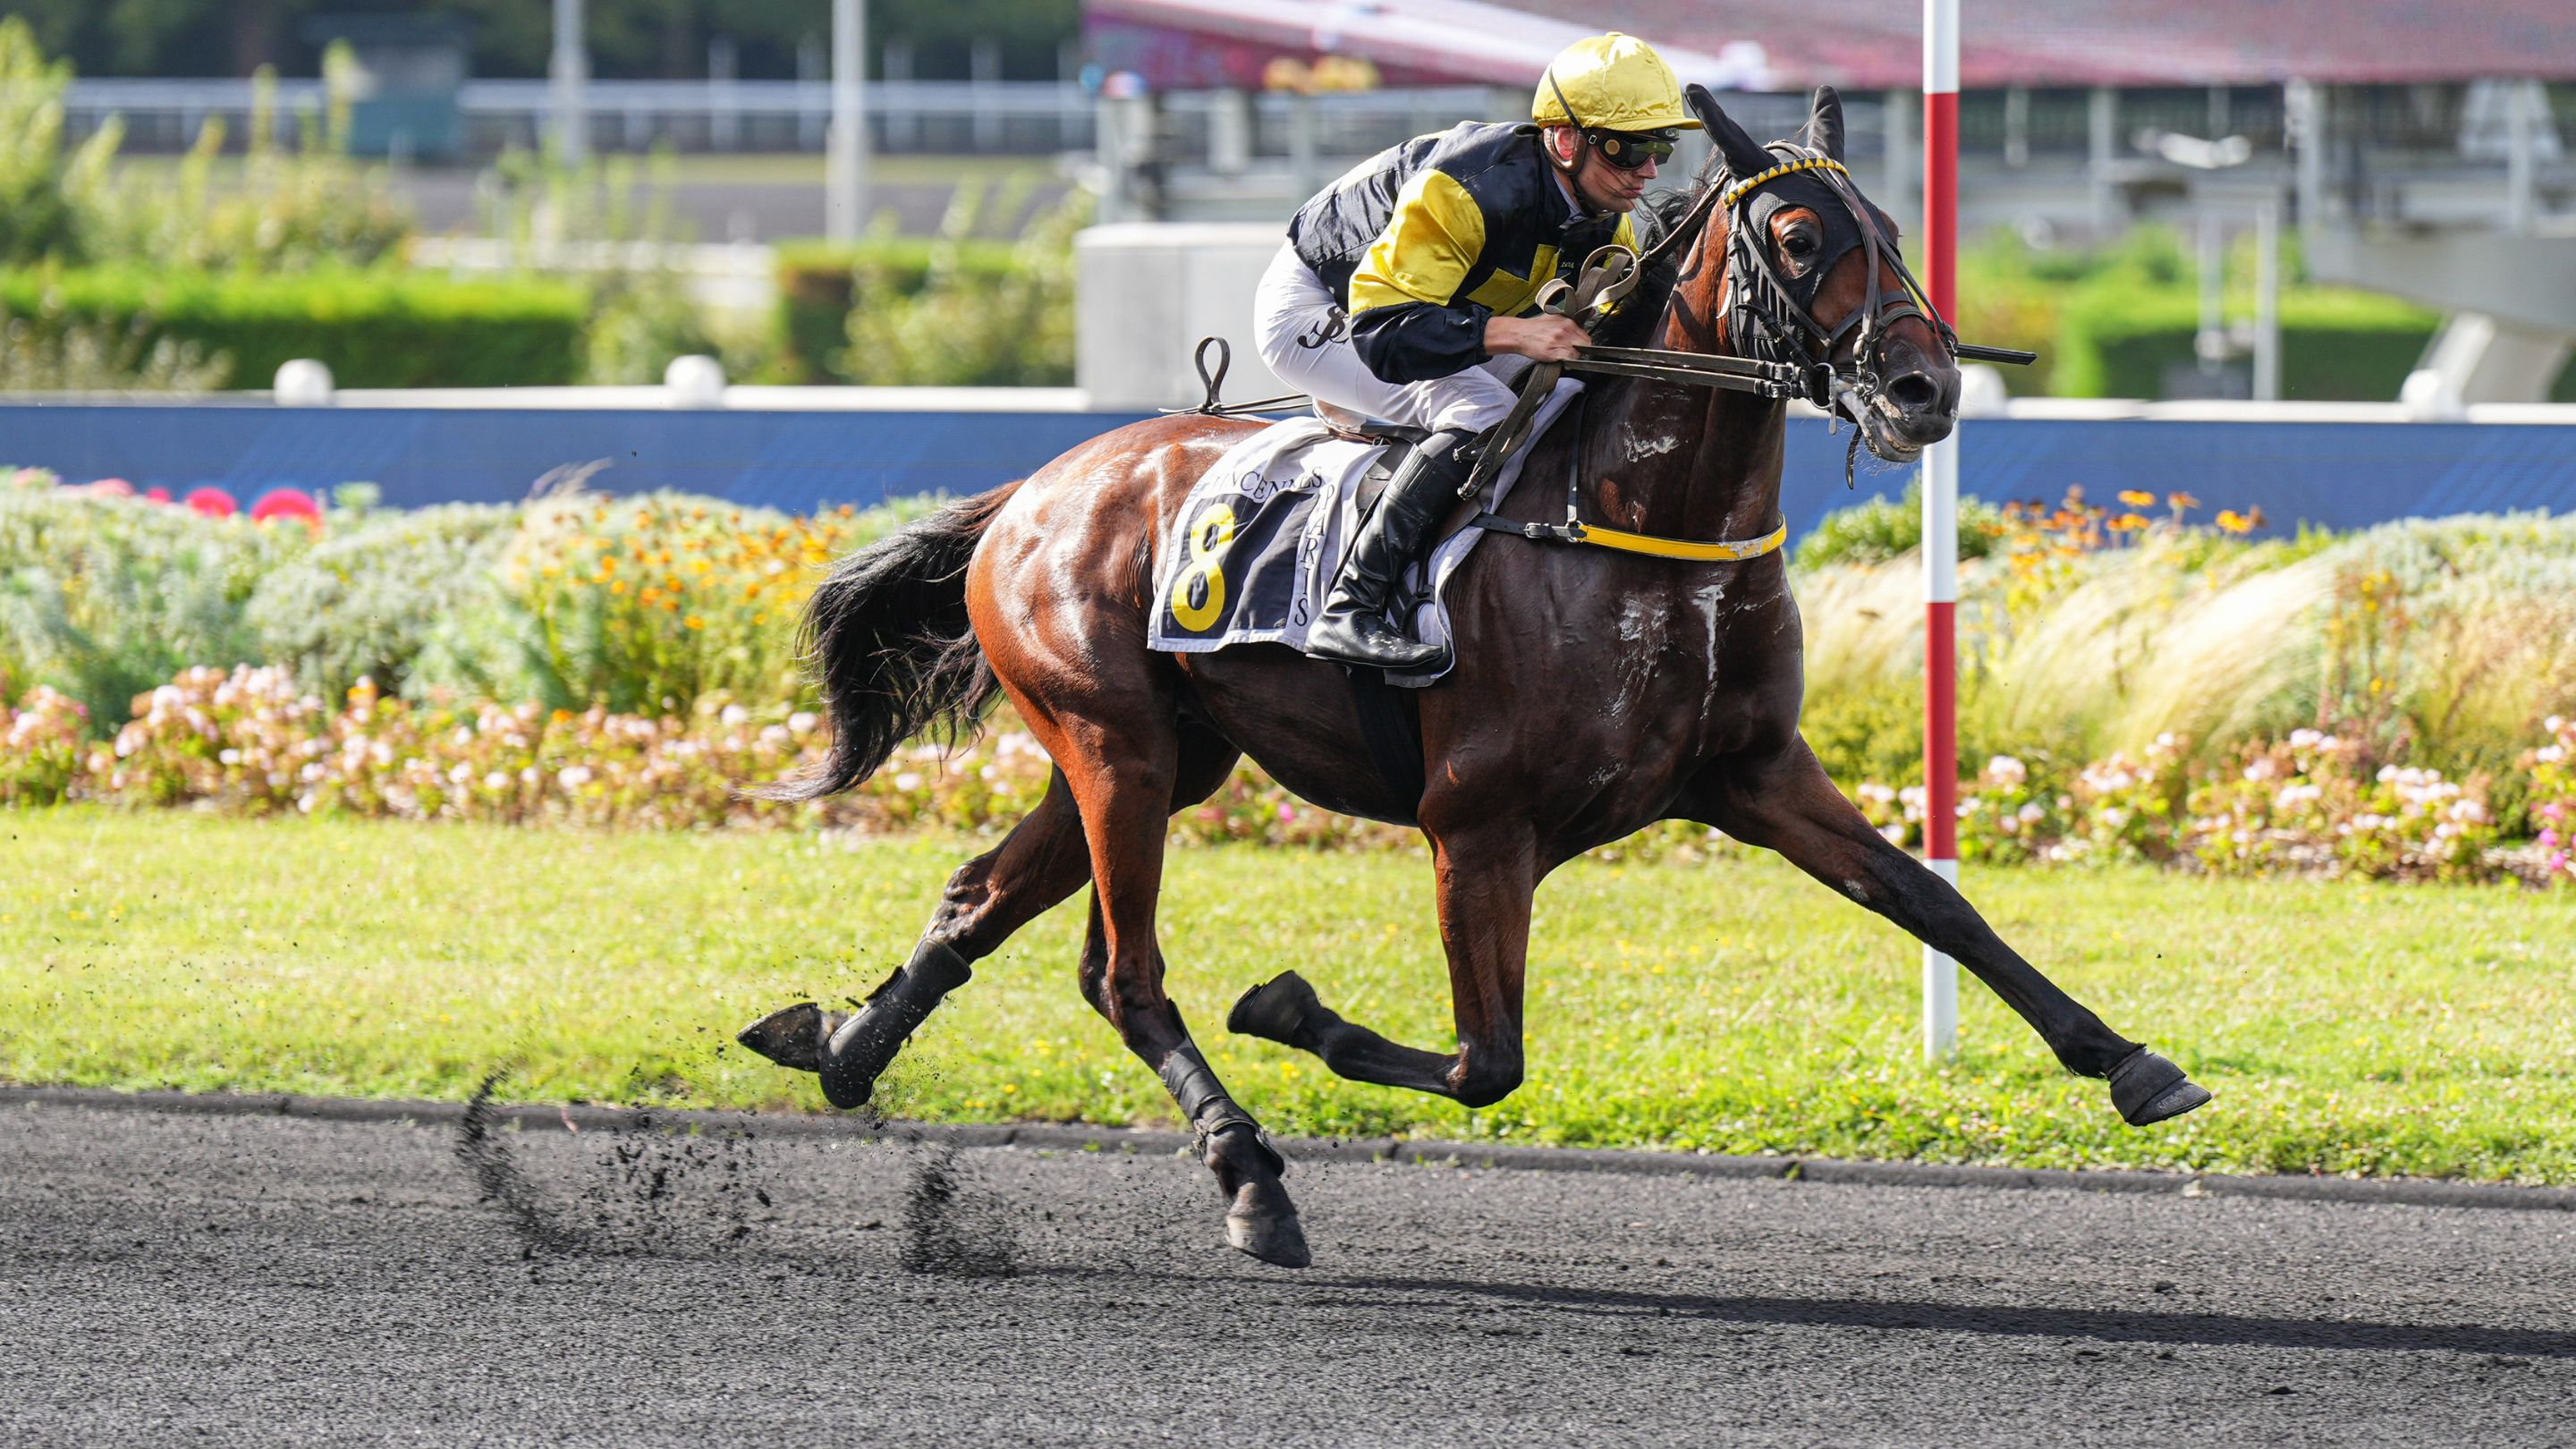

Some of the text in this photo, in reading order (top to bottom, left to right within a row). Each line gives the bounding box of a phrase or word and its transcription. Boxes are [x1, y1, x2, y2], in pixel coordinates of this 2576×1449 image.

[1211, 466, 1323, 500] INCENNES
[1171, 503, 1236, 632] 8
[1294, 484, 1335, 626] PARIS
